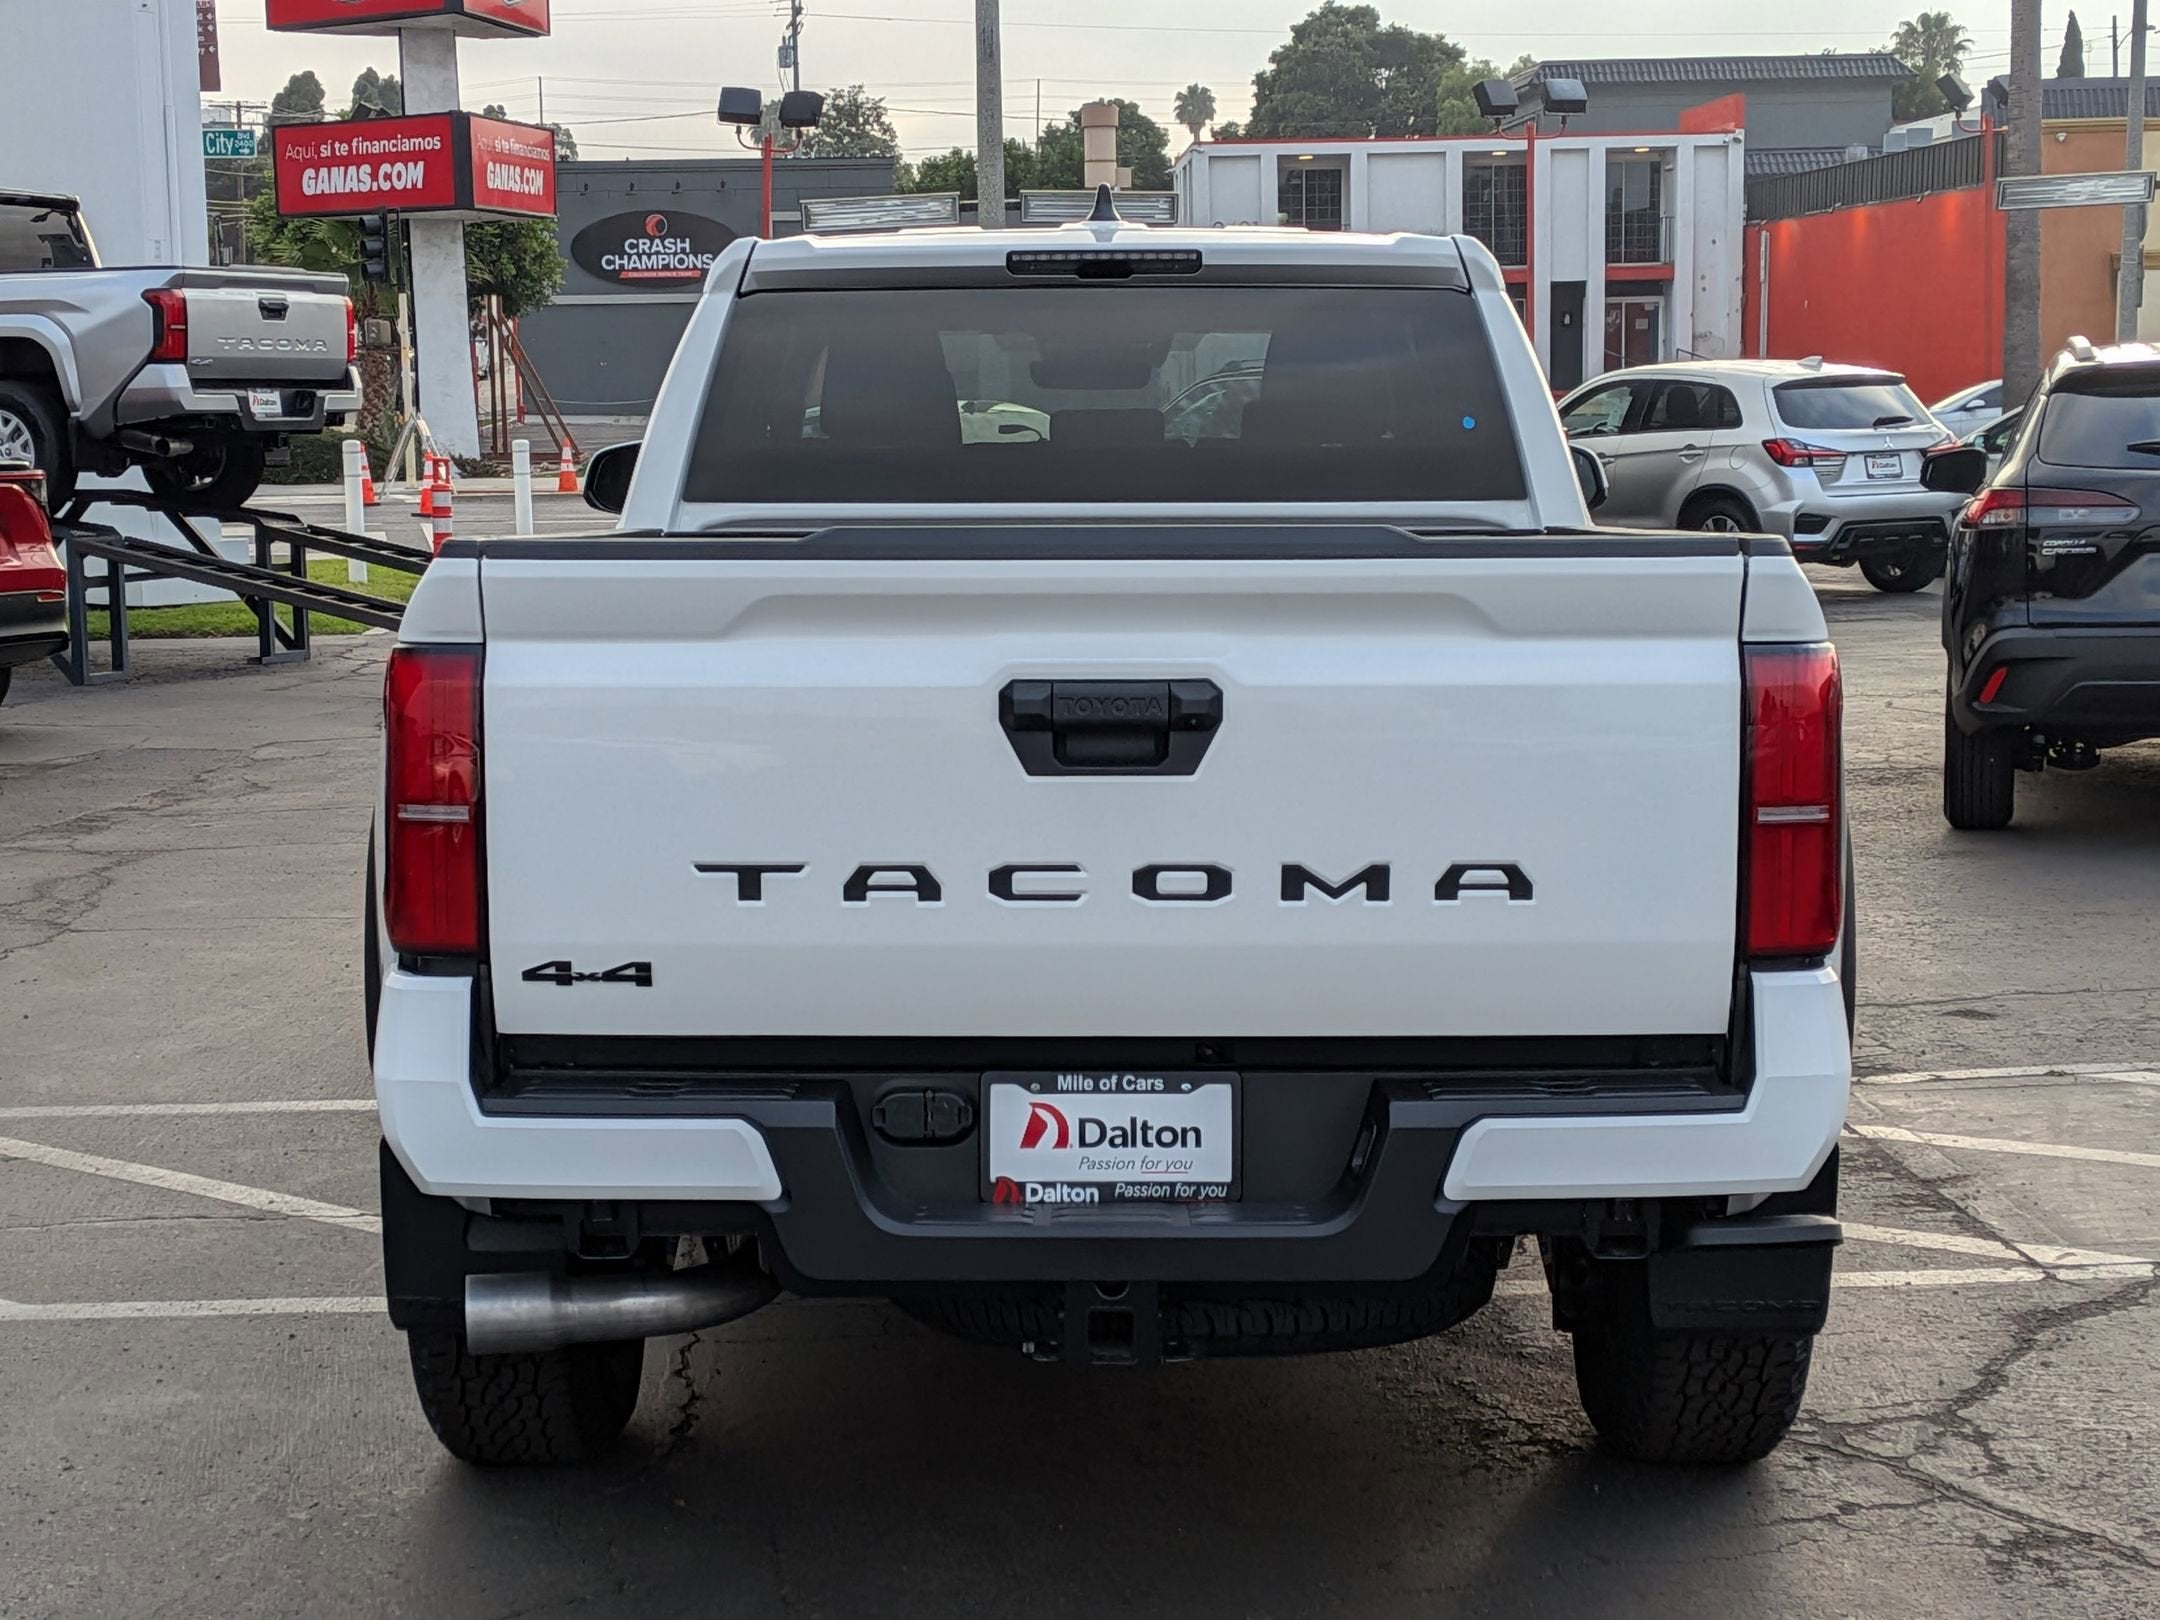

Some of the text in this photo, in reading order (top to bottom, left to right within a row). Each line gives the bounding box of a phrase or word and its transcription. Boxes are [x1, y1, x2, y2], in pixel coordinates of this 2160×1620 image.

[206, 132, 234, 155] City
[334, 139, 349, 157] te
[351, 133, 442, 156] financiamos
[301, 160, 425, 196] GANAS.COM
[486, 160, 544, 196] GANAS.COM
[624, 237, 690, 254] CRASH
[601, 253, 713, 270] CHAMPIONS
[217, 336, 328, 351] TACOMA
[1057, 696, 1163, 717] TOYOTA
[692, 862, 1536, 906] TACOMA
[521, 960, 653, 987] 4x4
[1057, 1073, 1165, 1092] Mile of Cars
[1078, 1116, 1202, 1149] Dalton
[1078, 1155, 1194, 1173] Passion for you
[1025, 1182, 1100, 1203] Dalton
[1114, 1182, 1228, 1200] Passion for you
